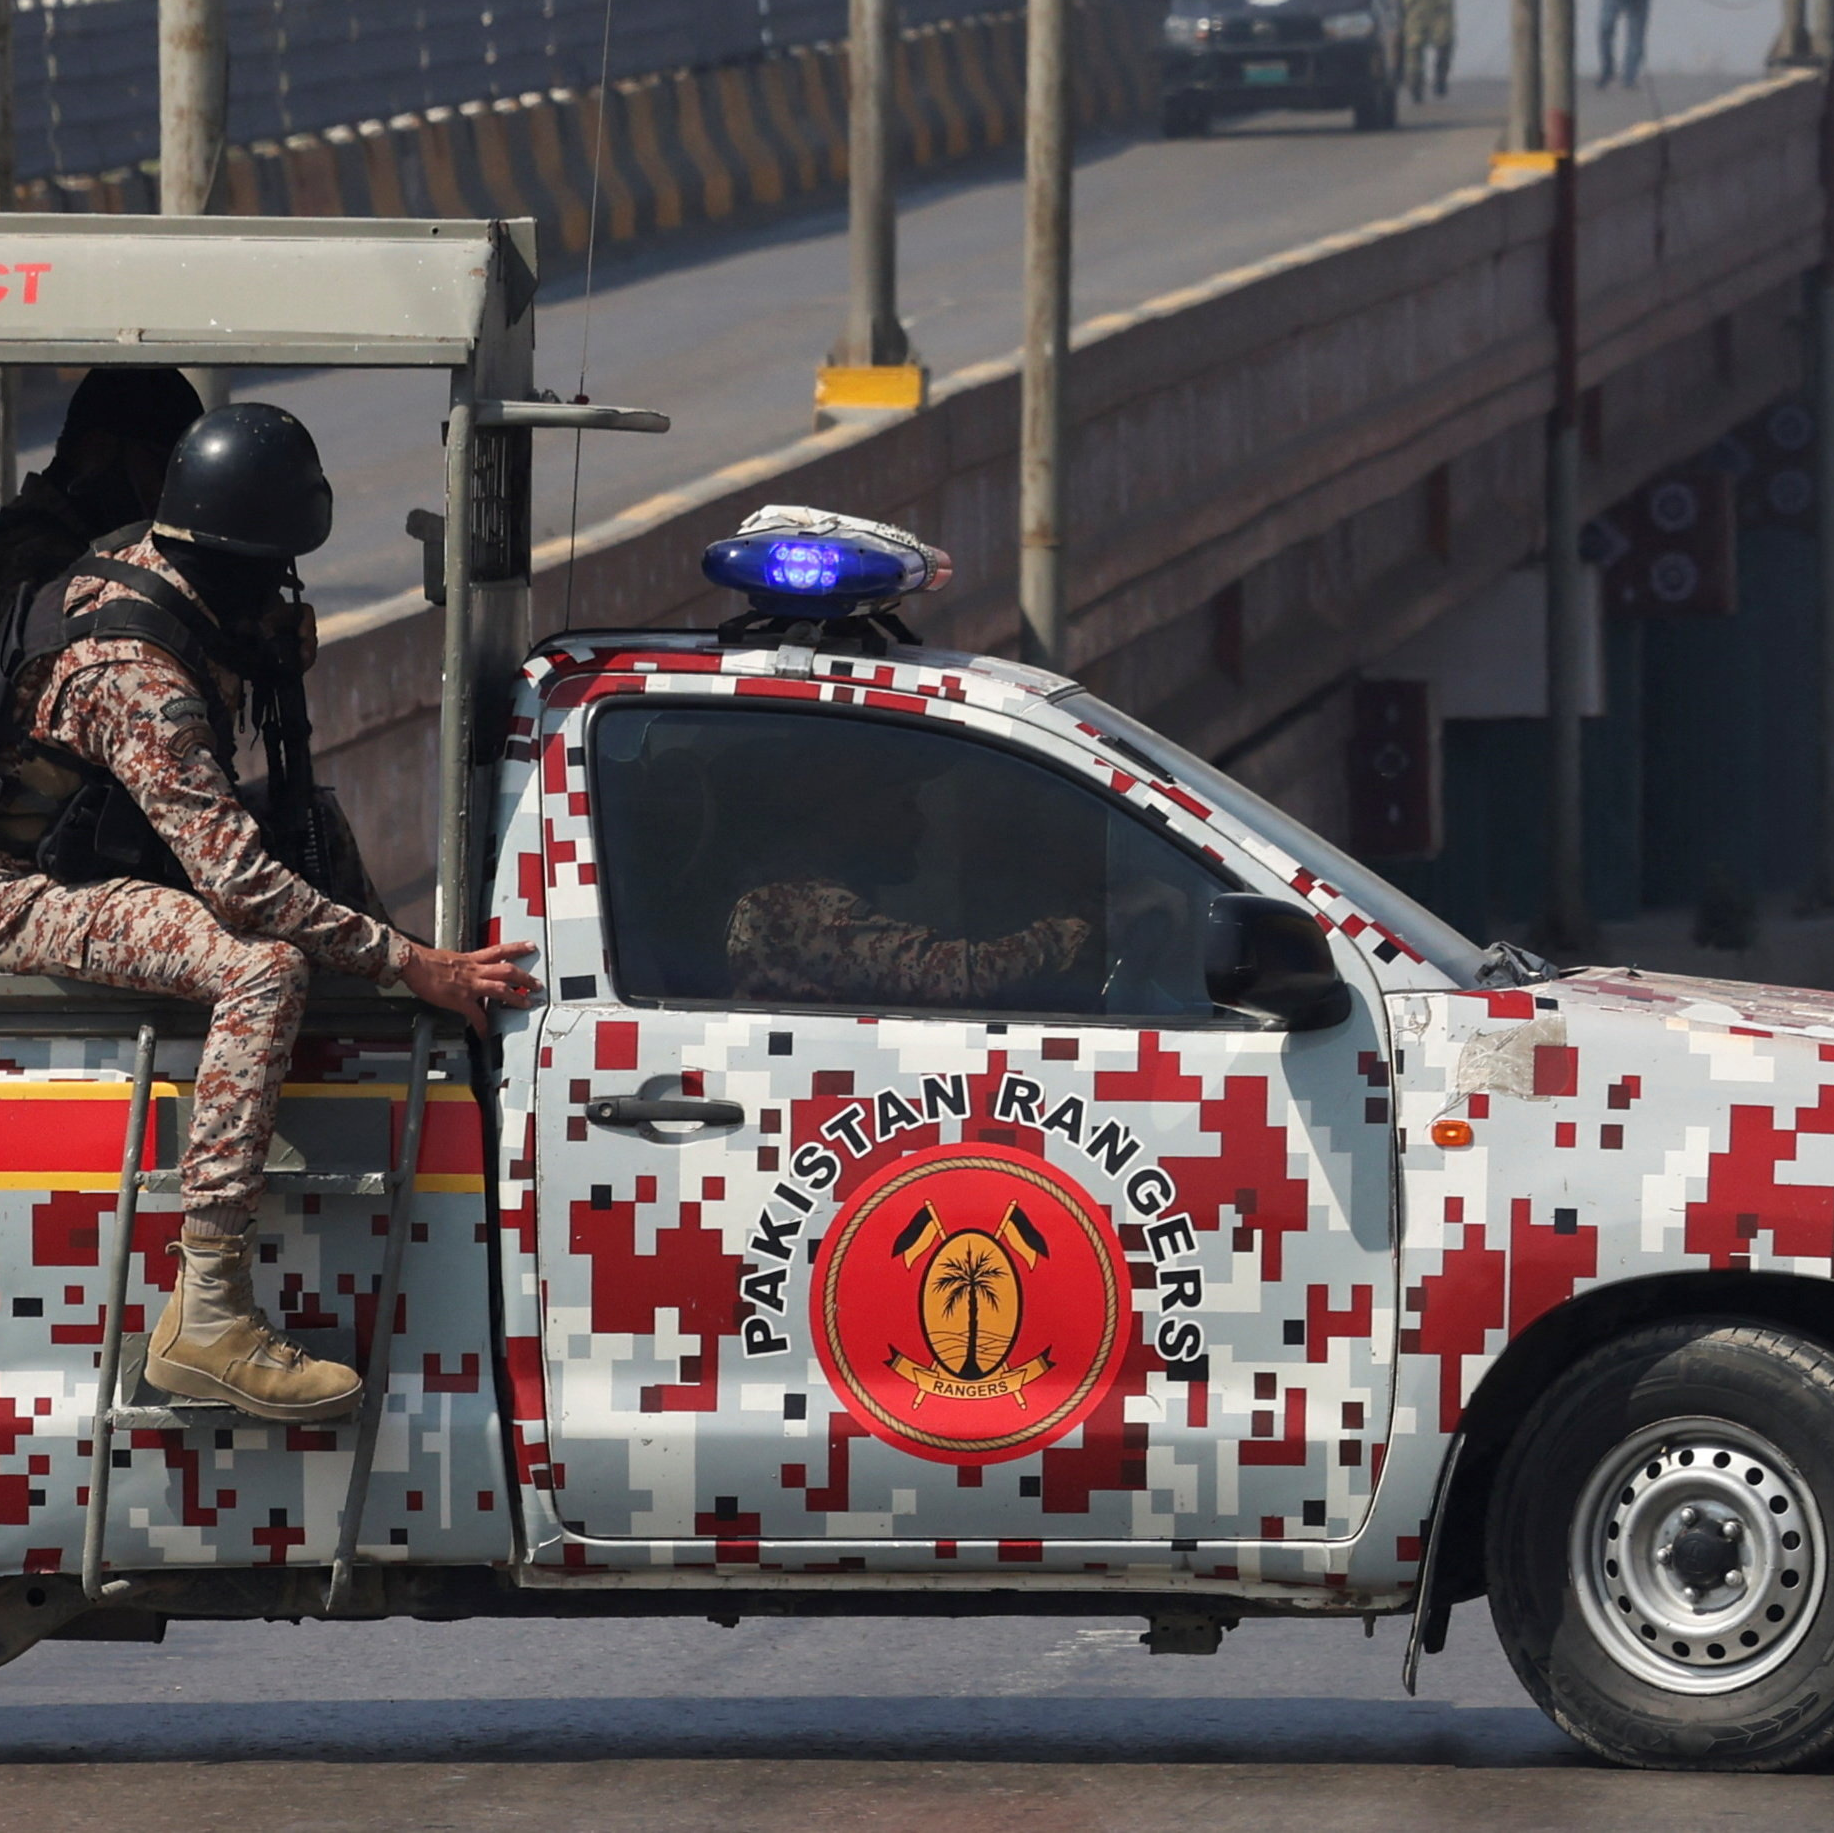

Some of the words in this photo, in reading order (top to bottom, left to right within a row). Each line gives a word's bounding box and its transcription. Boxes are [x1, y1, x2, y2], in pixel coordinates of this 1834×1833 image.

[741, 1073, 970, 1358] PAKISTAN
[994, 1072, 1203, 1363] RANGERS
[932, 1380, 1009, 1398] RANGERS
